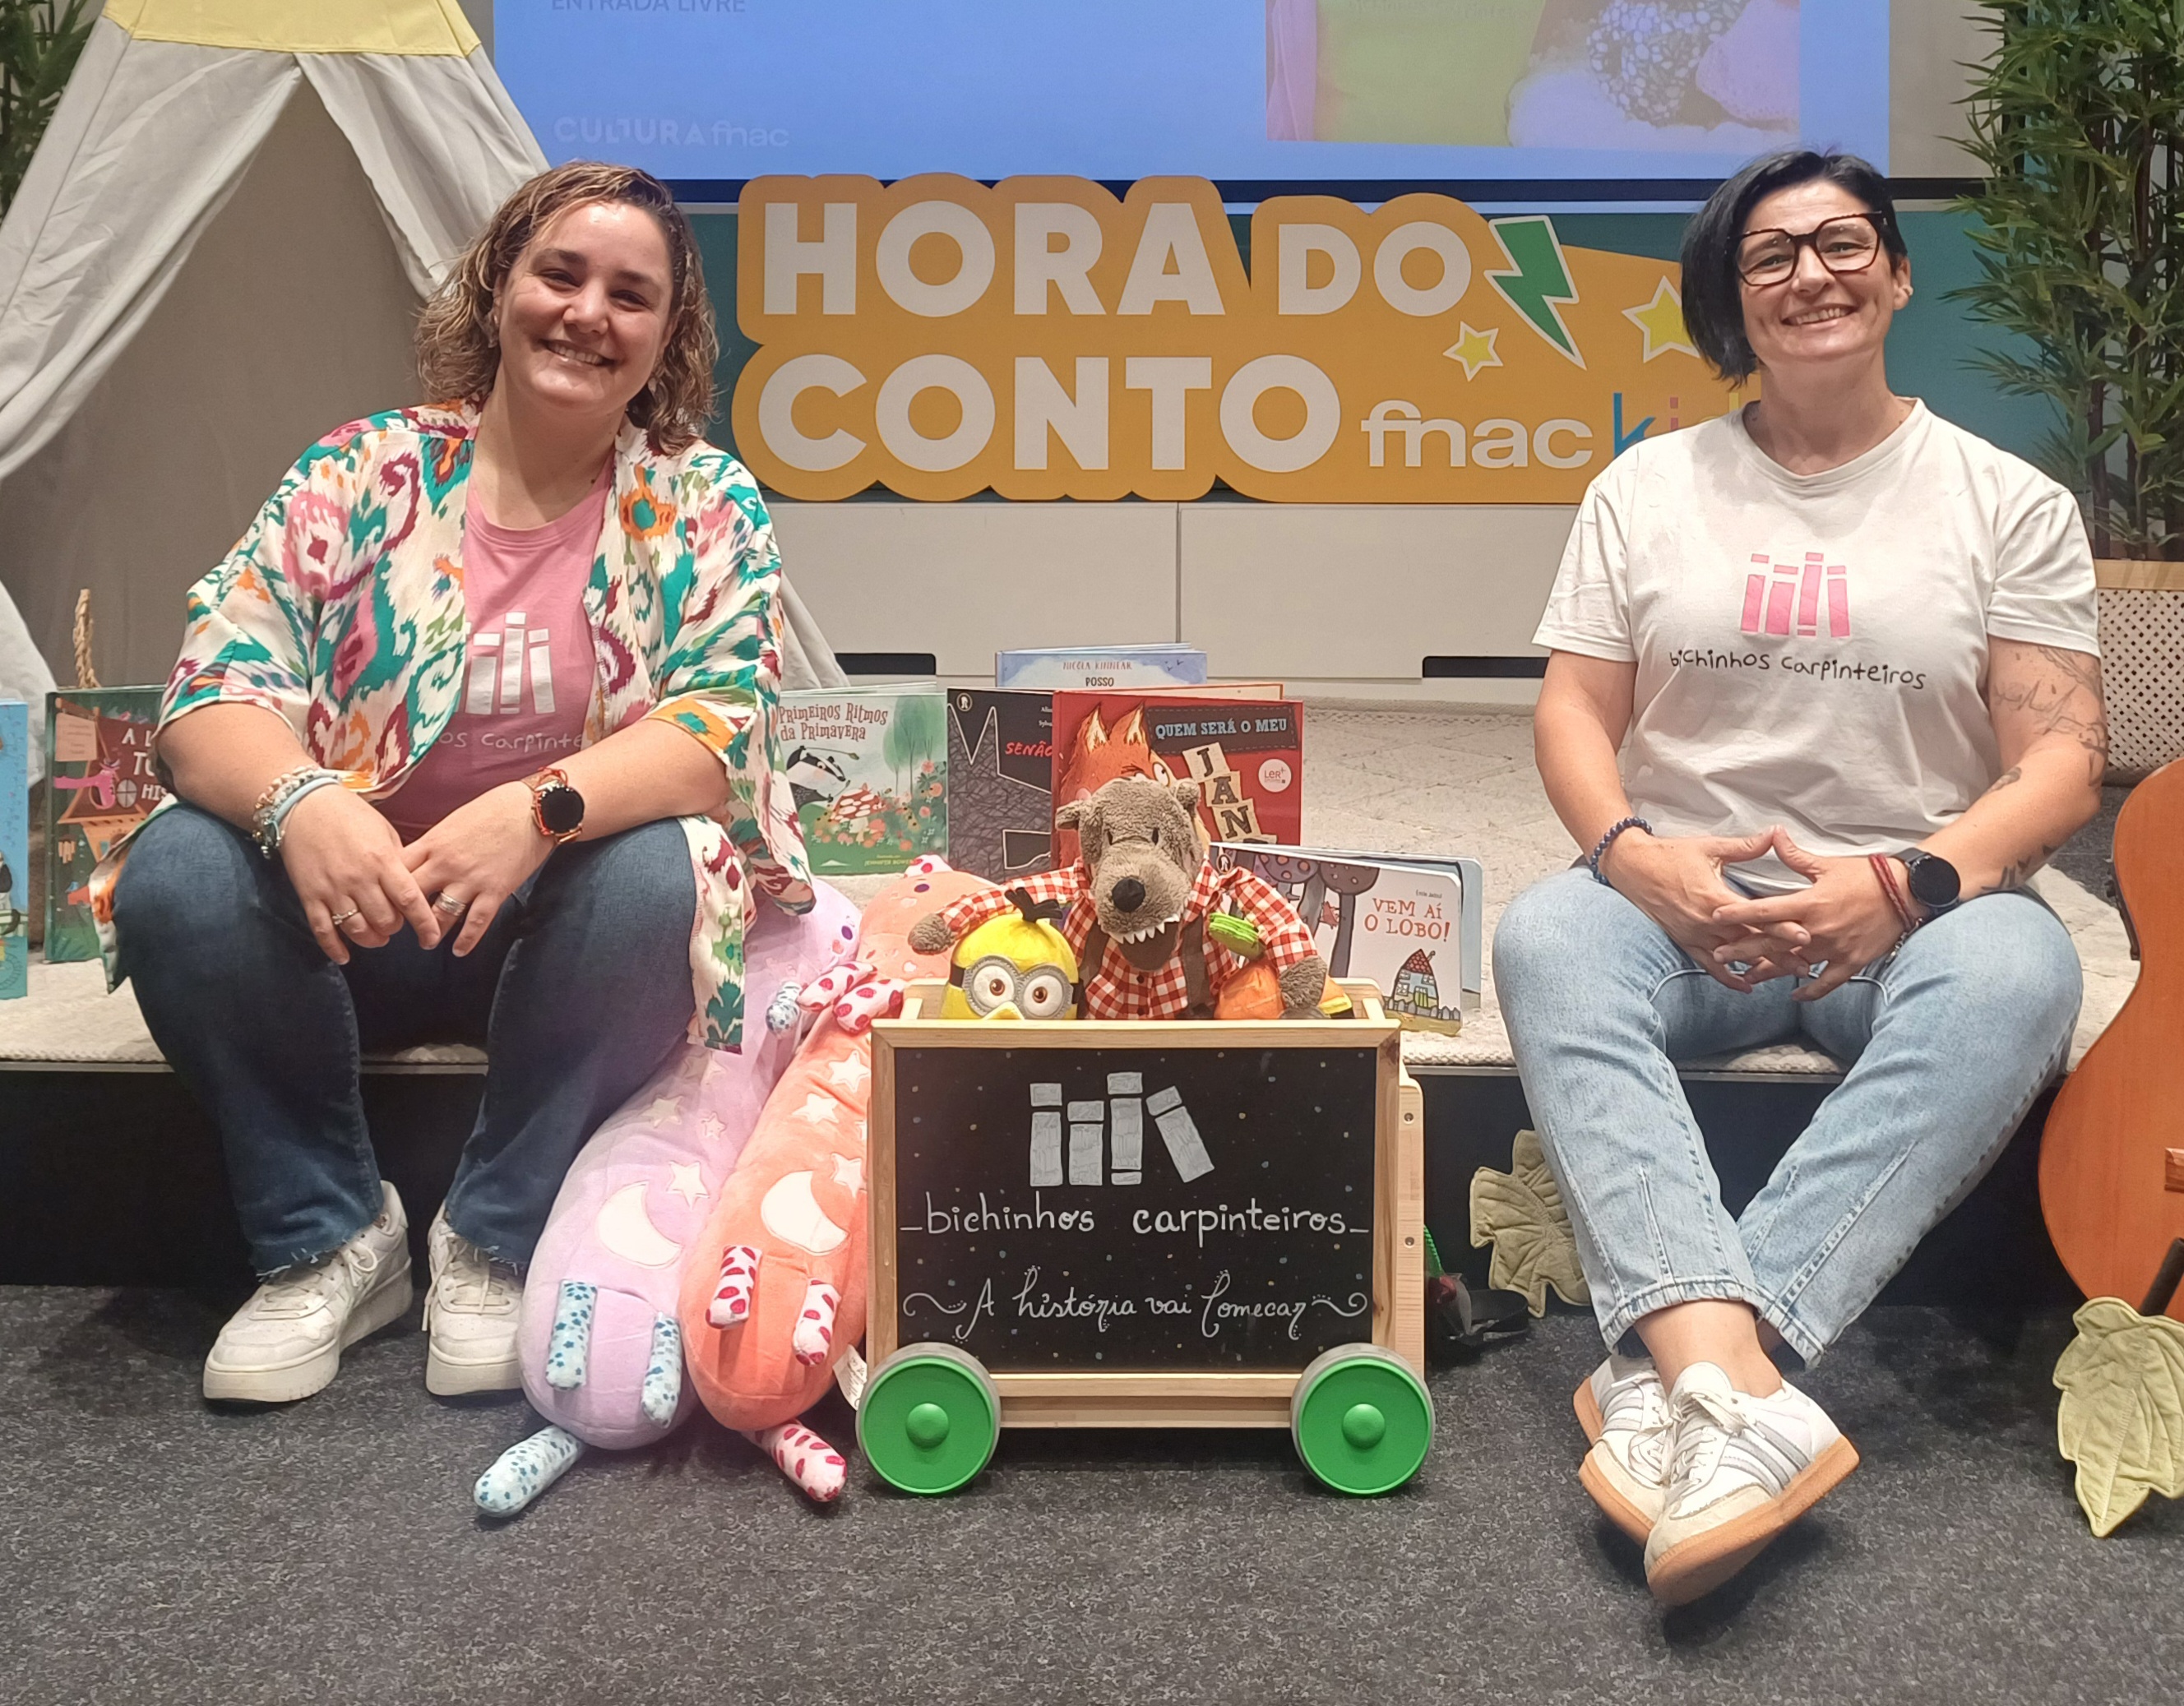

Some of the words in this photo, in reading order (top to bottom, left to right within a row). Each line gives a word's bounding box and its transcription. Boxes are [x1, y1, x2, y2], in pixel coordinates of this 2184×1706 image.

[552, 0, 669, 11] ENTRADA
[678, 0, 746, 12] LIVRE
[553, 117, 706, 146] CULTURA
[710, 119, 789, 146] fnac
[763, 201, 1225, 317] HORA
[1278, 222, 1472, 317] DO
[758, 354, 1340, 473] CONTO
[1361, 400, 1593, 469] fnac
[1085, 677, 1114, 687] POSSO
[122, 728, 136, 745] A
[780, 725, 796, 741] da
[1155, 723, 1196, 739] QUEM
[1201, 718, 1237, 735] SERÁ
[1240, 720, 1252, 733] O
[1255, 719, 1287, 733] MEU
[1372, 897, 1415, 918] VEM
[1426, 903, 1442, 919] AÍ
[1364, 914, 1378, 932] O
[1386, 918, 1450, 942] LOBO!
[925, 1191, 1095, 1234] bichinhos
[1132, 1198, 1346, 1248] carpinteiros
[955, 1278, 995, 1340] A
[1145, 1293, 1191, 1315] vai
